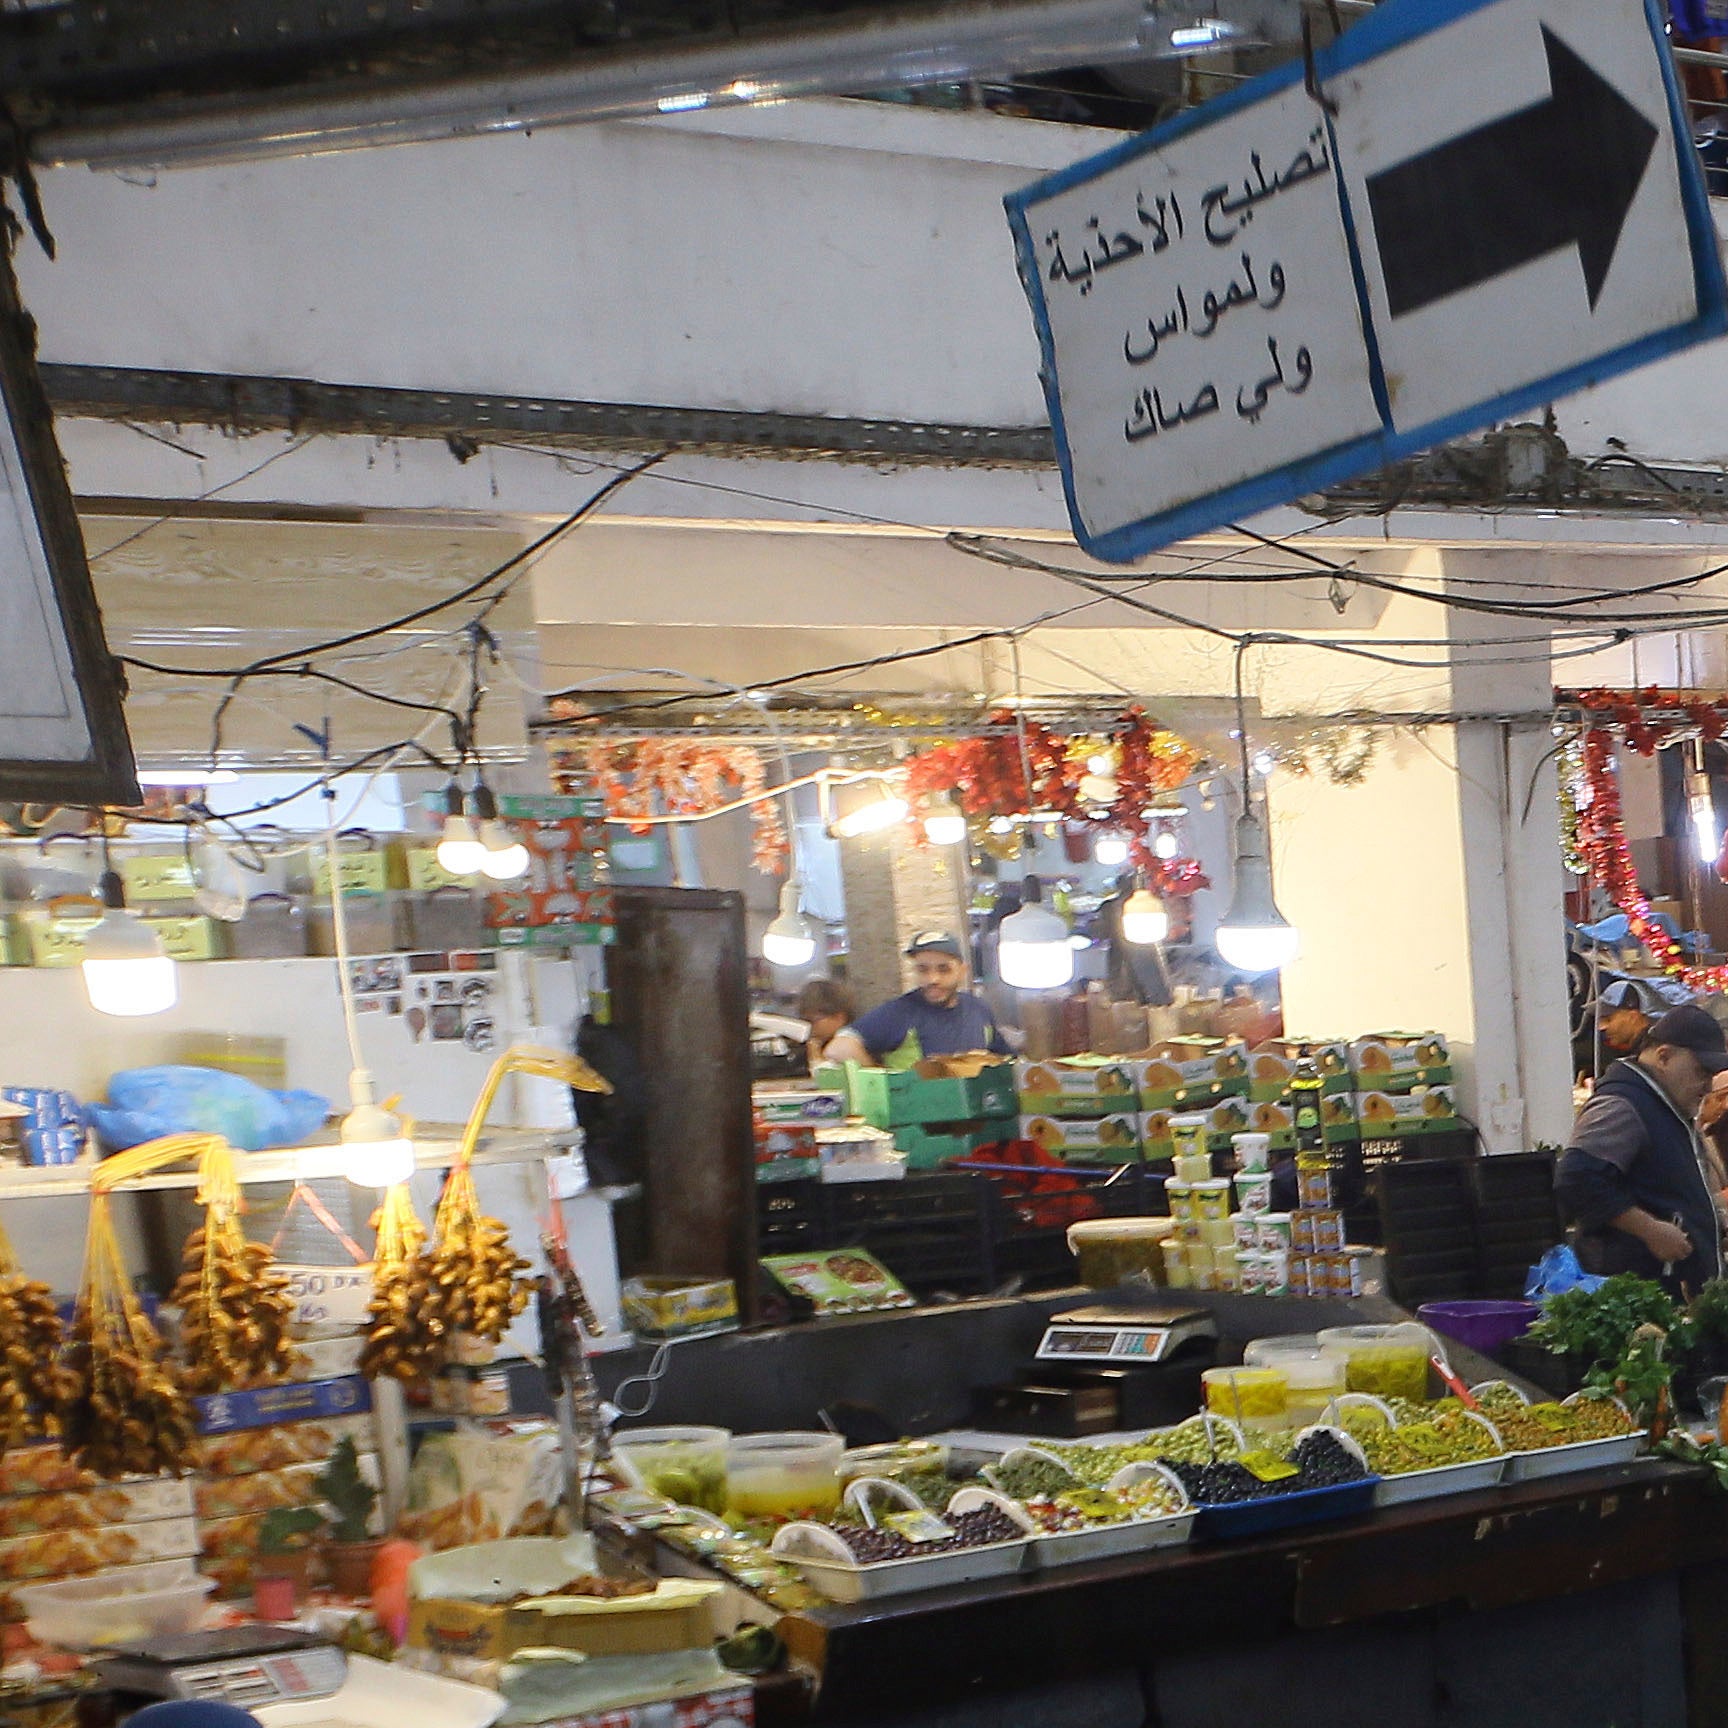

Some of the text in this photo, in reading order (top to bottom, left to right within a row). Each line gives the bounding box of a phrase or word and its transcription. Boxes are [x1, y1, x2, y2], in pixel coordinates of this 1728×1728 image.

[1045, 126, 1332, 296] تصليح الأحذية
[1122, 252, 1288, 366] ولمواس
[1123, 335, 1314, 444] ولي صاك
